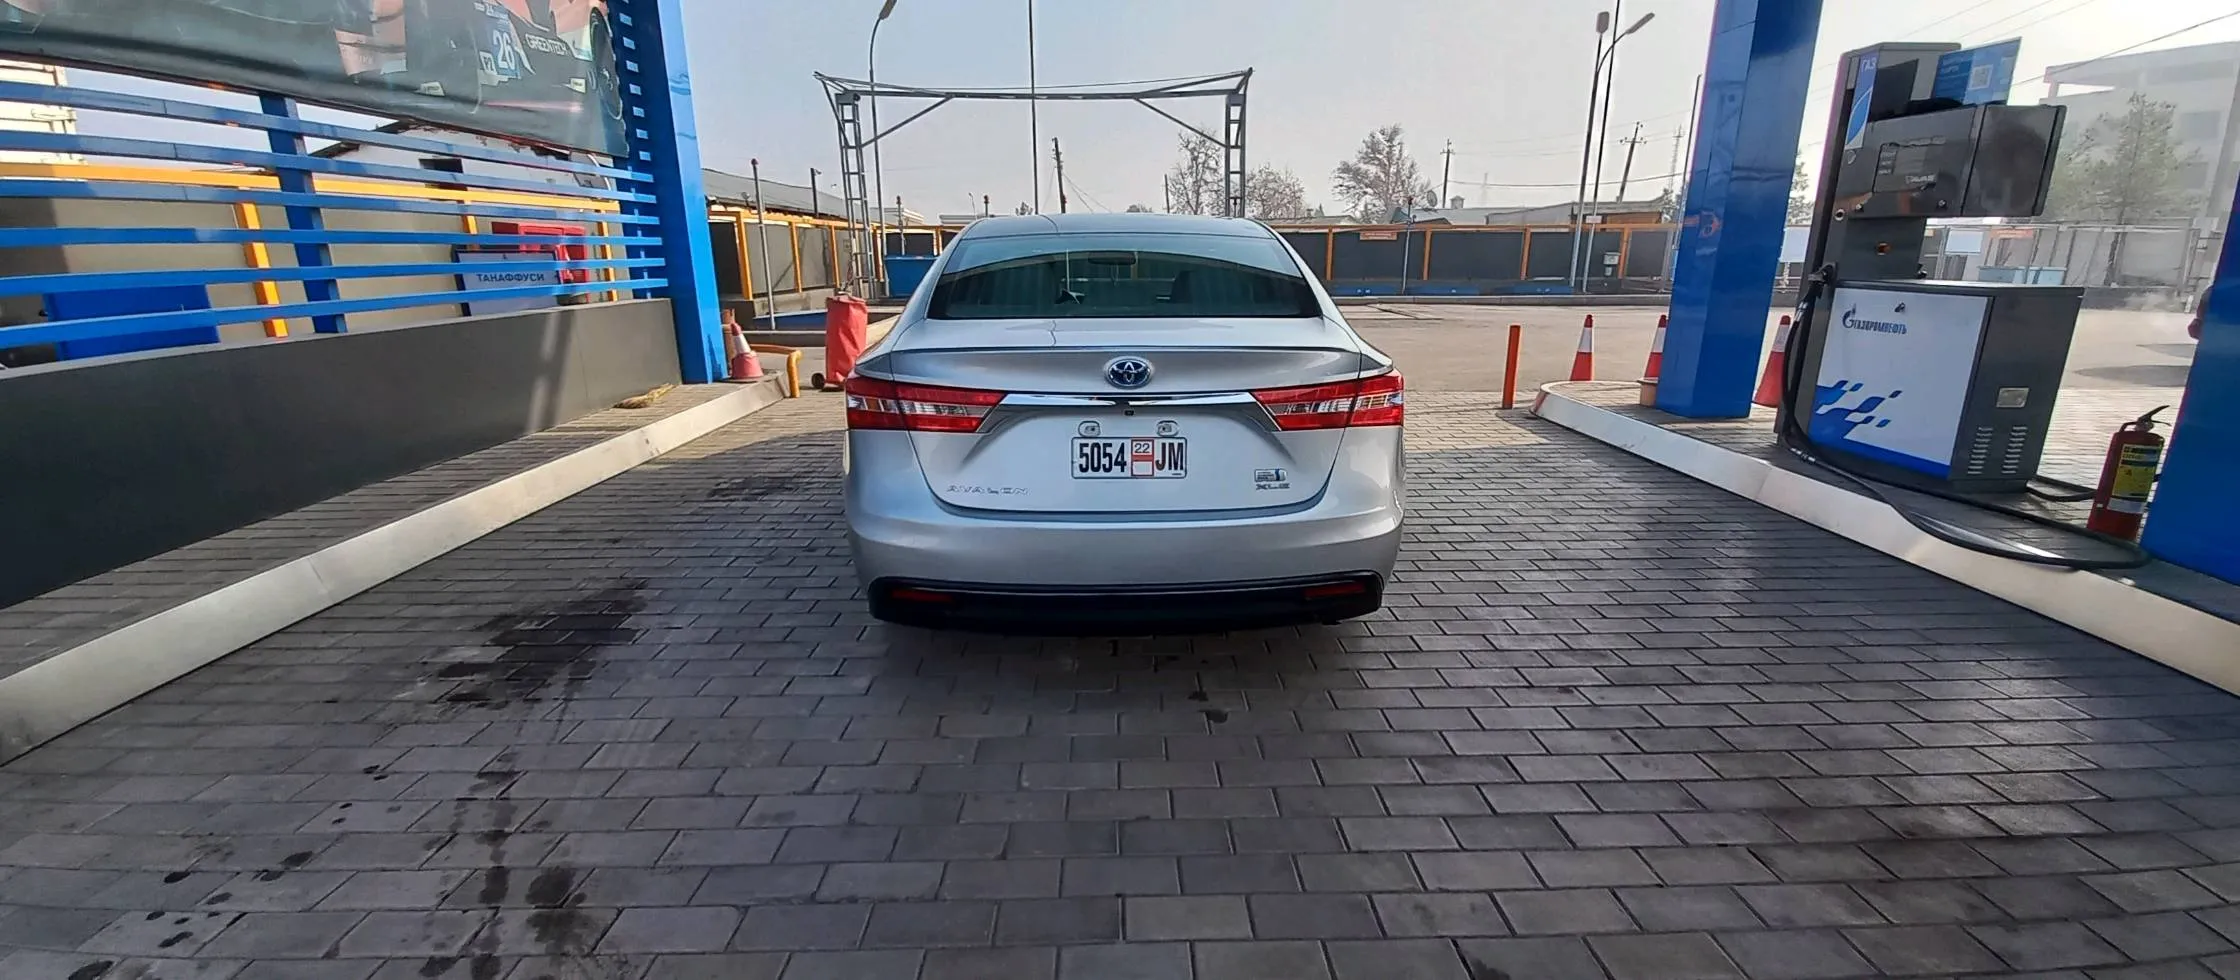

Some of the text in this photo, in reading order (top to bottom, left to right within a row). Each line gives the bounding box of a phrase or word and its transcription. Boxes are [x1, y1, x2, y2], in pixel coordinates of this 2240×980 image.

[493, 30, 515, 70] 26
[1861, 57, 1876, 72] ГАЗ
[477, 272, 545, 282] ТАНАФФУСИ
[1079, 442, 1184, 473] 5054 22 JM
